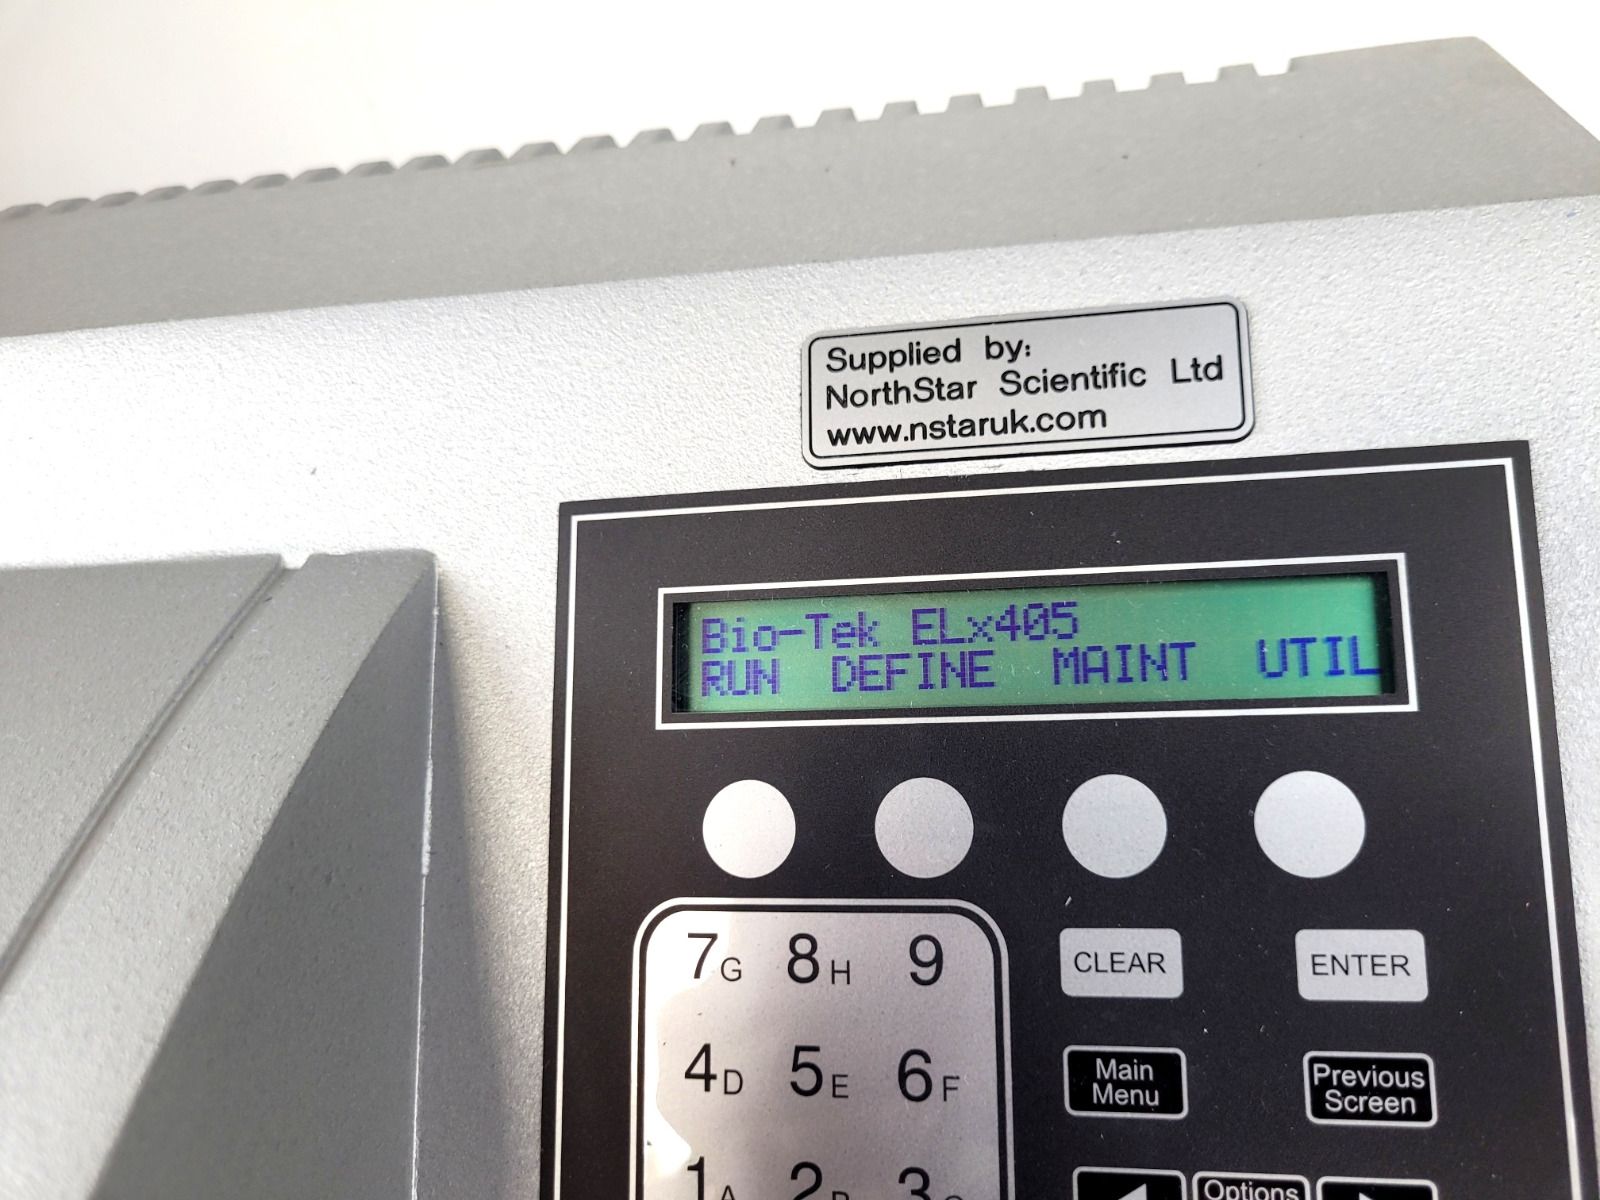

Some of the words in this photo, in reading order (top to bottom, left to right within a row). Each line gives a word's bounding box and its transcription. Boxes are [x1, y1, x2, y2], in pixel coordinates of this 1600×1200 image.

[826, 338, 961, 375] Supplied
[985, 335, 1031, 362] by:
[826, 376, 977, 409] NorthStar
[999, 363, 1147, 398] Scientific
[1171, 355, 1223, 385] Ltd
[827, 408, 1107, 447] www.nstaruk.com
[702, 611, 880, 654] Bio-Tek
[911, 601, 1078, 646] ELx405
[702, 659, 780, 696] RUN
[831, 650, 995, 692] DEFINE
[1053, 642, 1196, 685] MAINT
[1257, 635, 1383, 678] UTIL
[909, 934, 944, 986] 9
[1073, 951, 1167, 975] CLEAR
[1311, 954, 1412, 977] ENTER
[1095, 1058, 1154, 1082] Main
[1313, 1063, 1425, 1090] Previous
[1093, 1083, 1160, 1107] Menu
[1325, 1090, 1417, 1115] Screen
[1204, 1179, 1299, 1200] Options
